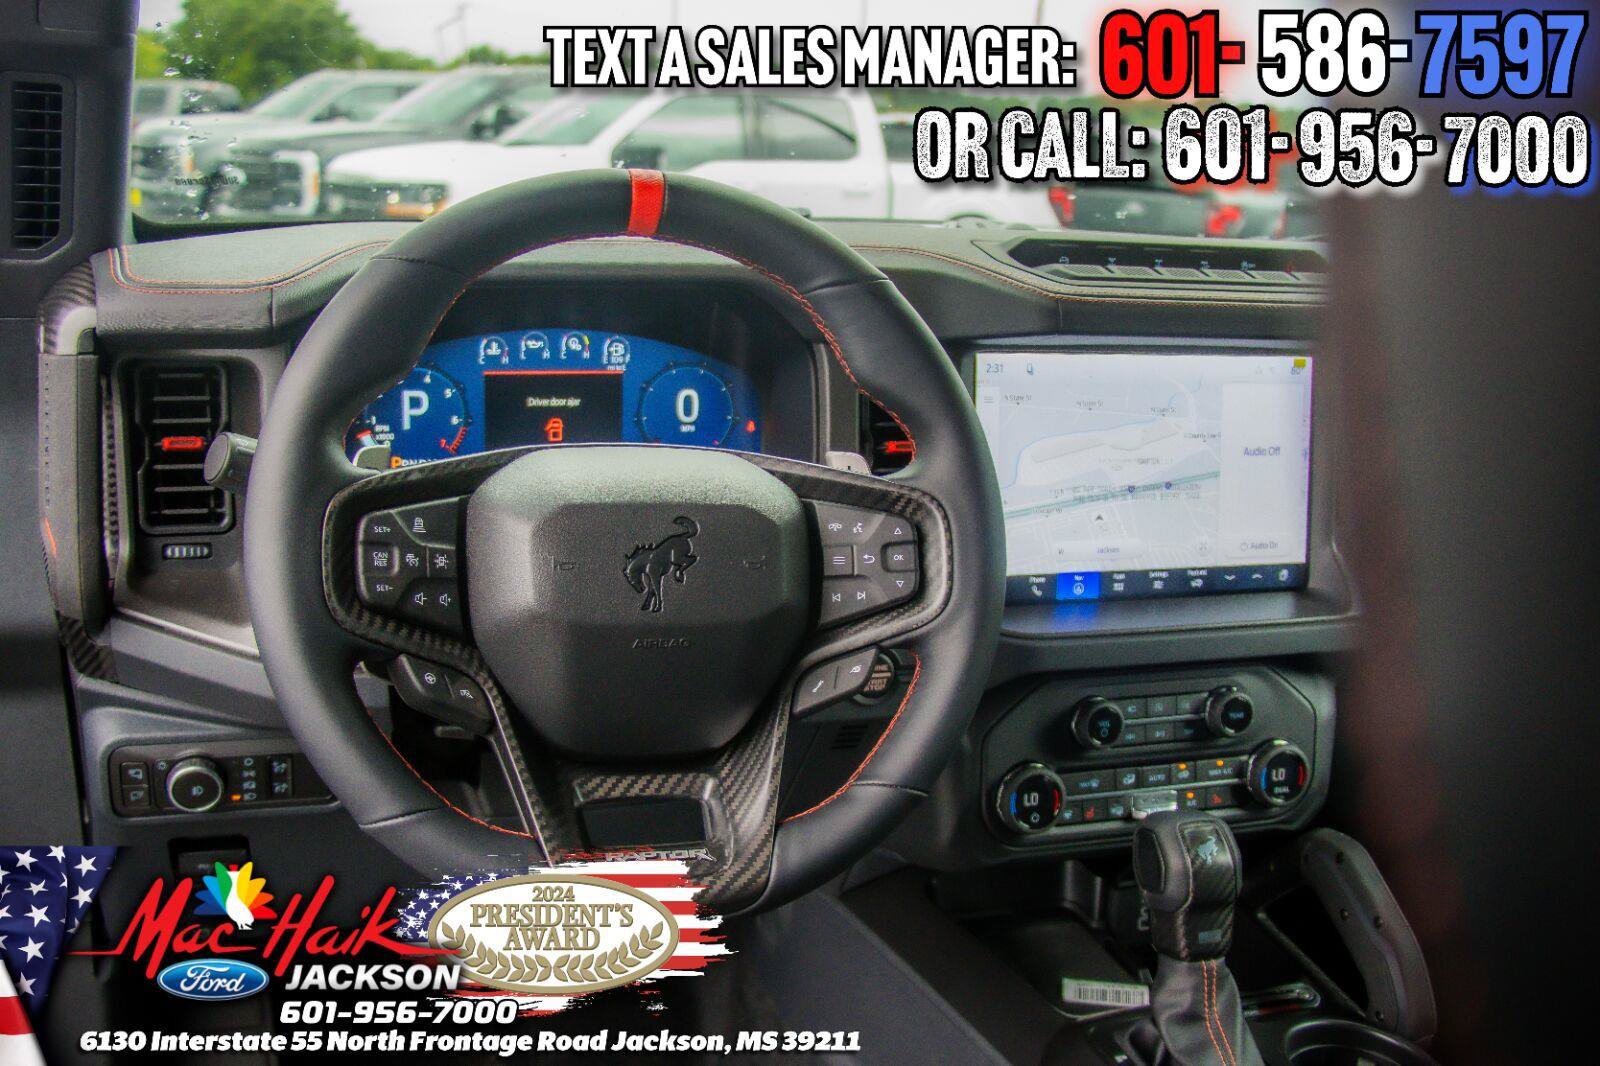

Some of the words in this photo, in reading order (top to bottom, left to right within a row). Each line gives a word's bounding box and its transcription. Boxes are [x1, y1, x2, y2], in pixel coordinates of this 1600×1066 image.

[402, 390, 430, 431] P
[676, 388, 700, 424] 0
[1244, 447, 1266, 456] Audio
[1268, 447, 1280, 456] Off
[632, 639, 689, 649] AIRBAG
